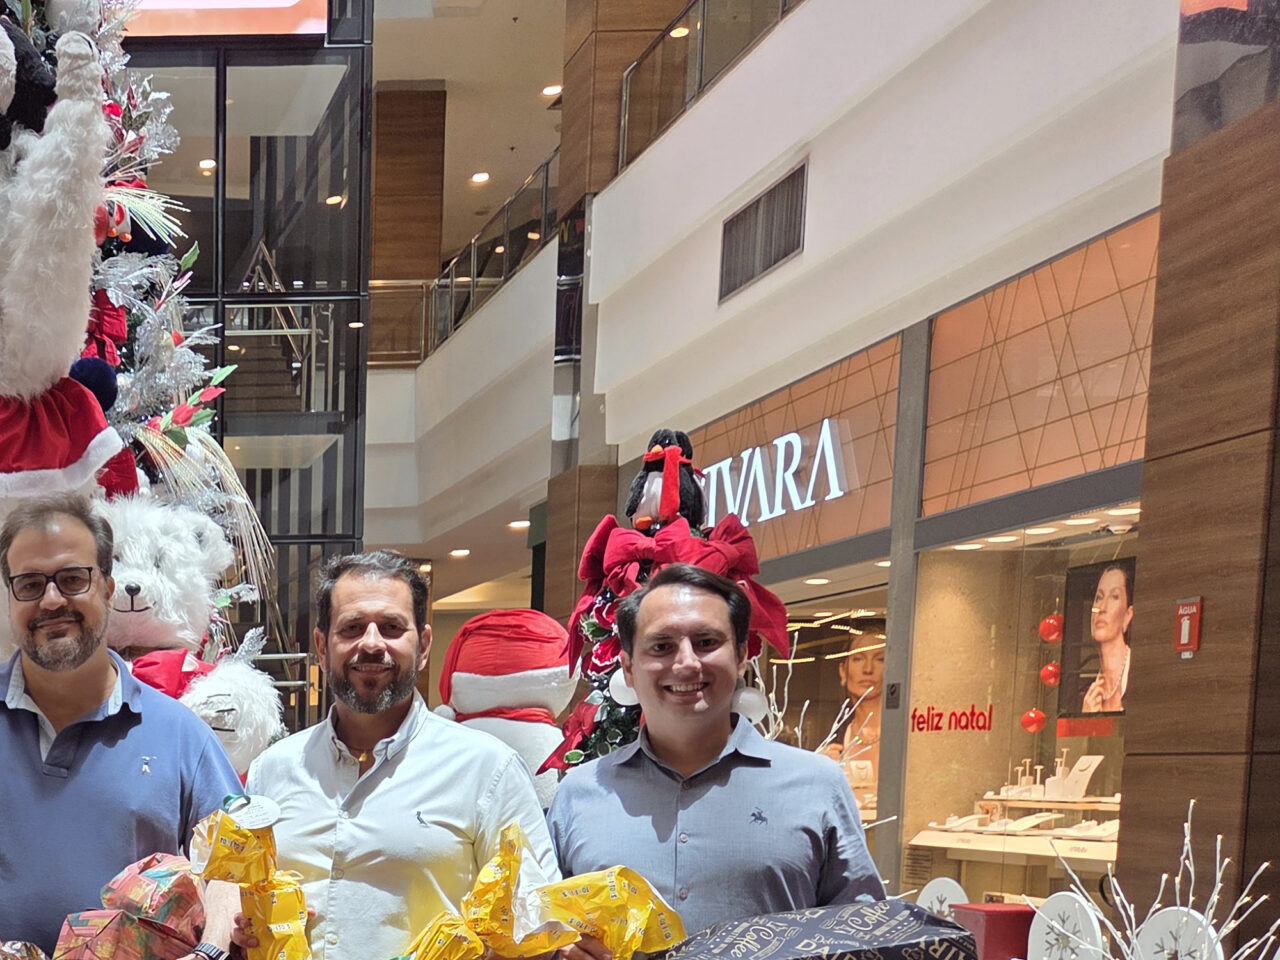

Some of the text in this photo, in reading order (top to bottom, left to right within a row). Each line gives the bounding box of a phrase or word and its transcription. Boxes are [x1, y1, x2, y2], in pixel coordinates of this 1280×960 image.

[701, 418, 844, 528] IVARA
[911, 703, 994, 733] feliz natal
[847, 902, 891, 932] Coffee
[730, 925, 774, 959] Coffee
